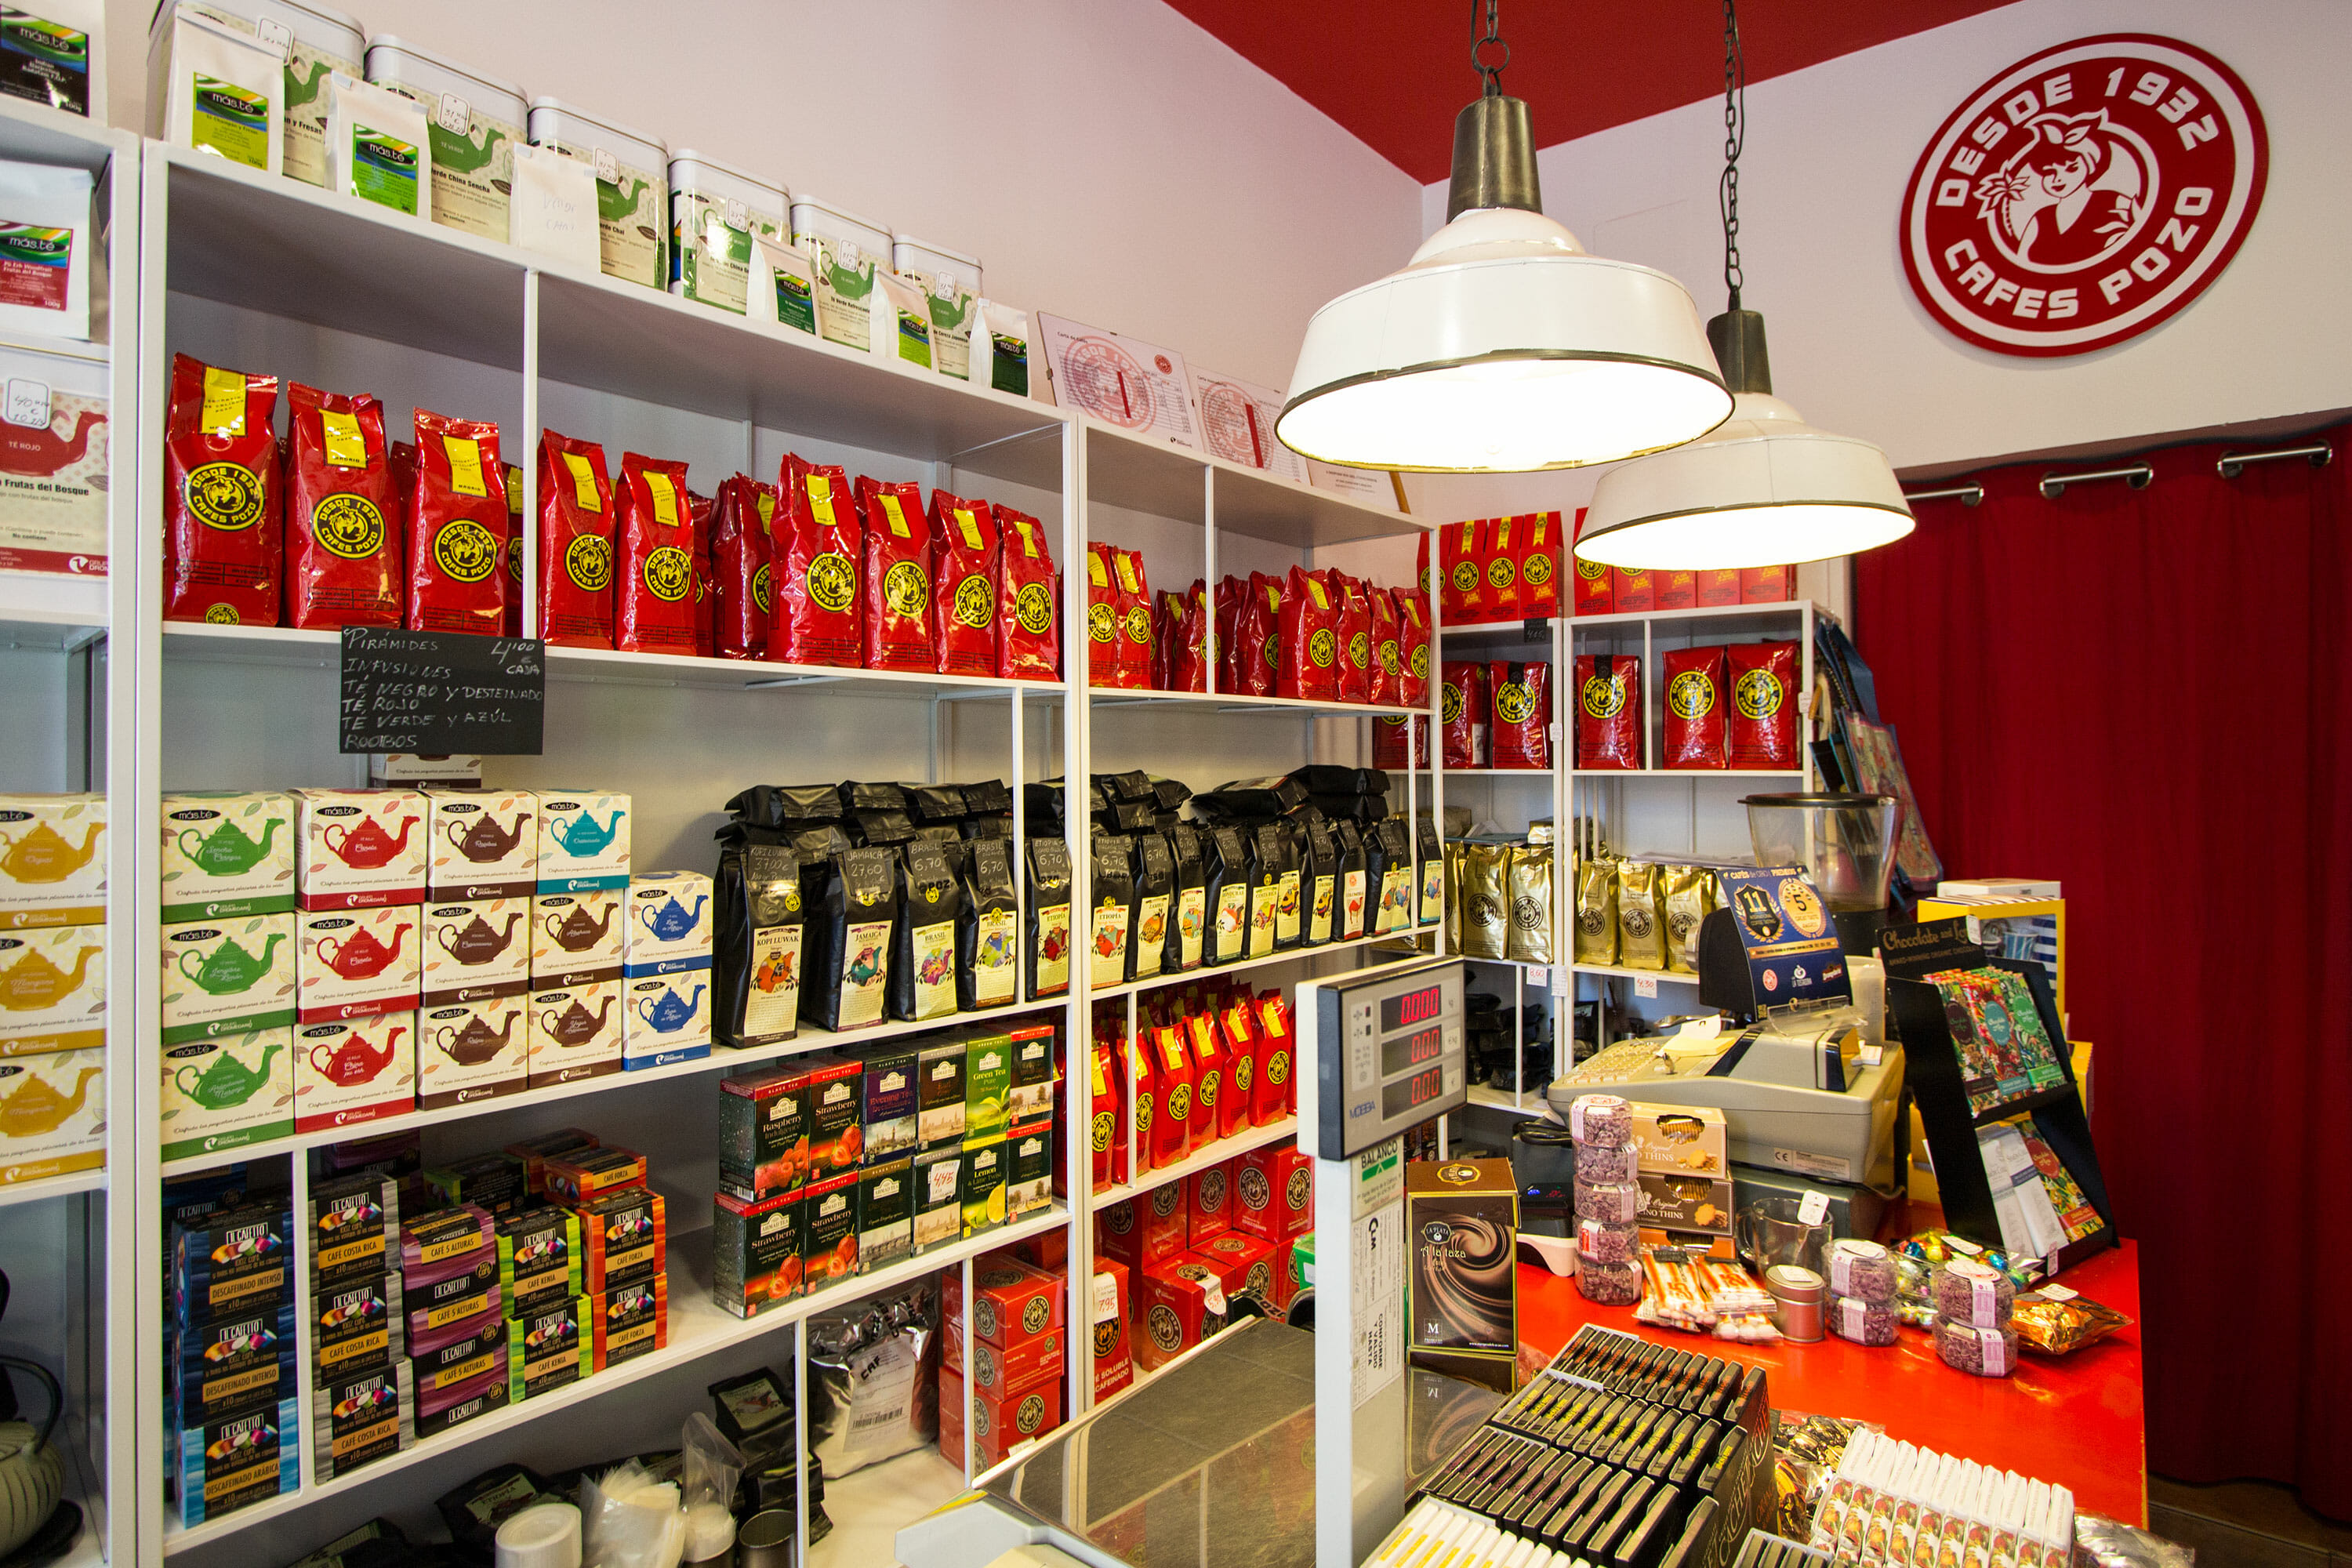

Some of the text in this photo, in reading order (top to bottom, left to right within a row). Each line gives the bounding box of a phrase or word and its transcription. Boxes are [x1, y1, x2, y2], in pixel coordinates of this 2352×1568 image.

[20, 27, 69, 51] más.té
[212, 93, 254, 114] más.té
[299, 122, 322, 135] Fresas
[1936, 67, 2219, 206] DESDE 1932
[369, 143, 405, 162] más.té
[431, 168, 490, 194] erde China Sencha
[10, 237, 55, 252] más.té
[1944, 187, 2214, 319] CAFES POZO
[8, 441, 41, 452] TÉ ROJO
[5, 479, 89, 496] Frutas del Bosque
[192, 467, 260, 495] DESDE 1932
[192, 496, 257, 523] CAFES POZO
[318, 499, 378, 526] DESDE 1932
[321, 526, 378, 553] CAFES POZO
[441, 524, 493, 554] DESDE 1932
[442, 551, 492, 576] CAFES POZO
[343, 628, 438, 650] PIRÁMIDES
[343, 658, 452, 679] INFUSIONES
[343, 675, 368, 694] TÉ
[376, 683, 437, 697] NEGRO
[342, 694, 420, 713] TÉ ROJO
[342, 709, 367, 730] TÉ
[377, 714, 436, 728] VERDE
[345, 735, 418, 750] ROOIBOS
[179, 810, 212, 821] más.té
[325, 807, 355, 816] más.té
[448, 803, 475, 813] más.té
[551, 802, 575, 811] más.té
[848, 851, 883, 862] JAMAICA
[977, 843, 1004, 855] BRASIL
[914, 857, 941, 872] 6,70
[980, 861, 1004, 874] 6,70
[1744, 891, 1766, 913] 11
[1792, 895, 1806, 911] 5
[439, 906, 466, 917] más.té
[317, 918, 348, 928] más.té
[180, 930, 213, 941] más.té
[855, 931, 882, 941] JAMAICA
[1883, 927, 1940, 950] Chocolate
[973, 1070, 990, 1080] Green
[869, 1093, 899, 1105] Evening
[815, 1100, 858, 1117] Strawberry
[763, 1115, 803, 1133] Raspberry
[1361, 1140, 1398, 1169] BALANCO
[1645, 1152, 1674, 1162] THINS
[1774, 1151, 1788, 1162] CE
[975, 1167, 996, 1177] Lemon
[811, 1209, 853, 1229] Strawberry
[1658, 1210, 1683, 1220] THINS
[431, 1245, 445, 1258] CAFÉ
[451, 1236, 474, 1252] ALTURAS
[751, 1228, 797, 1249] Strawberry
[327, 1240, 377, 1262] CAFÉ COSTA RICA
[1432, 1247, 1442, 1257] la
[212, 1272, 282, 1299] DESCAFEINADO INTENSO
[527, 1273, 556, 1288] CAFÉ KENIA
[1098, 1297, 1116, 1312] 7,95
[1428, 1323, 1439, 1334] M
[329, 1336, 380, 1359] CAFÉ COSTA RICA
[1101, 1357, 1129, 1377] SOLUBLE
[205, 1369, 278, 1397] DESCAFEINADO INTENSO
[1094, 1368, 1129, 1393] CAFEINADO
[206, 1472, 252, 1497] DESCAFEINADO
